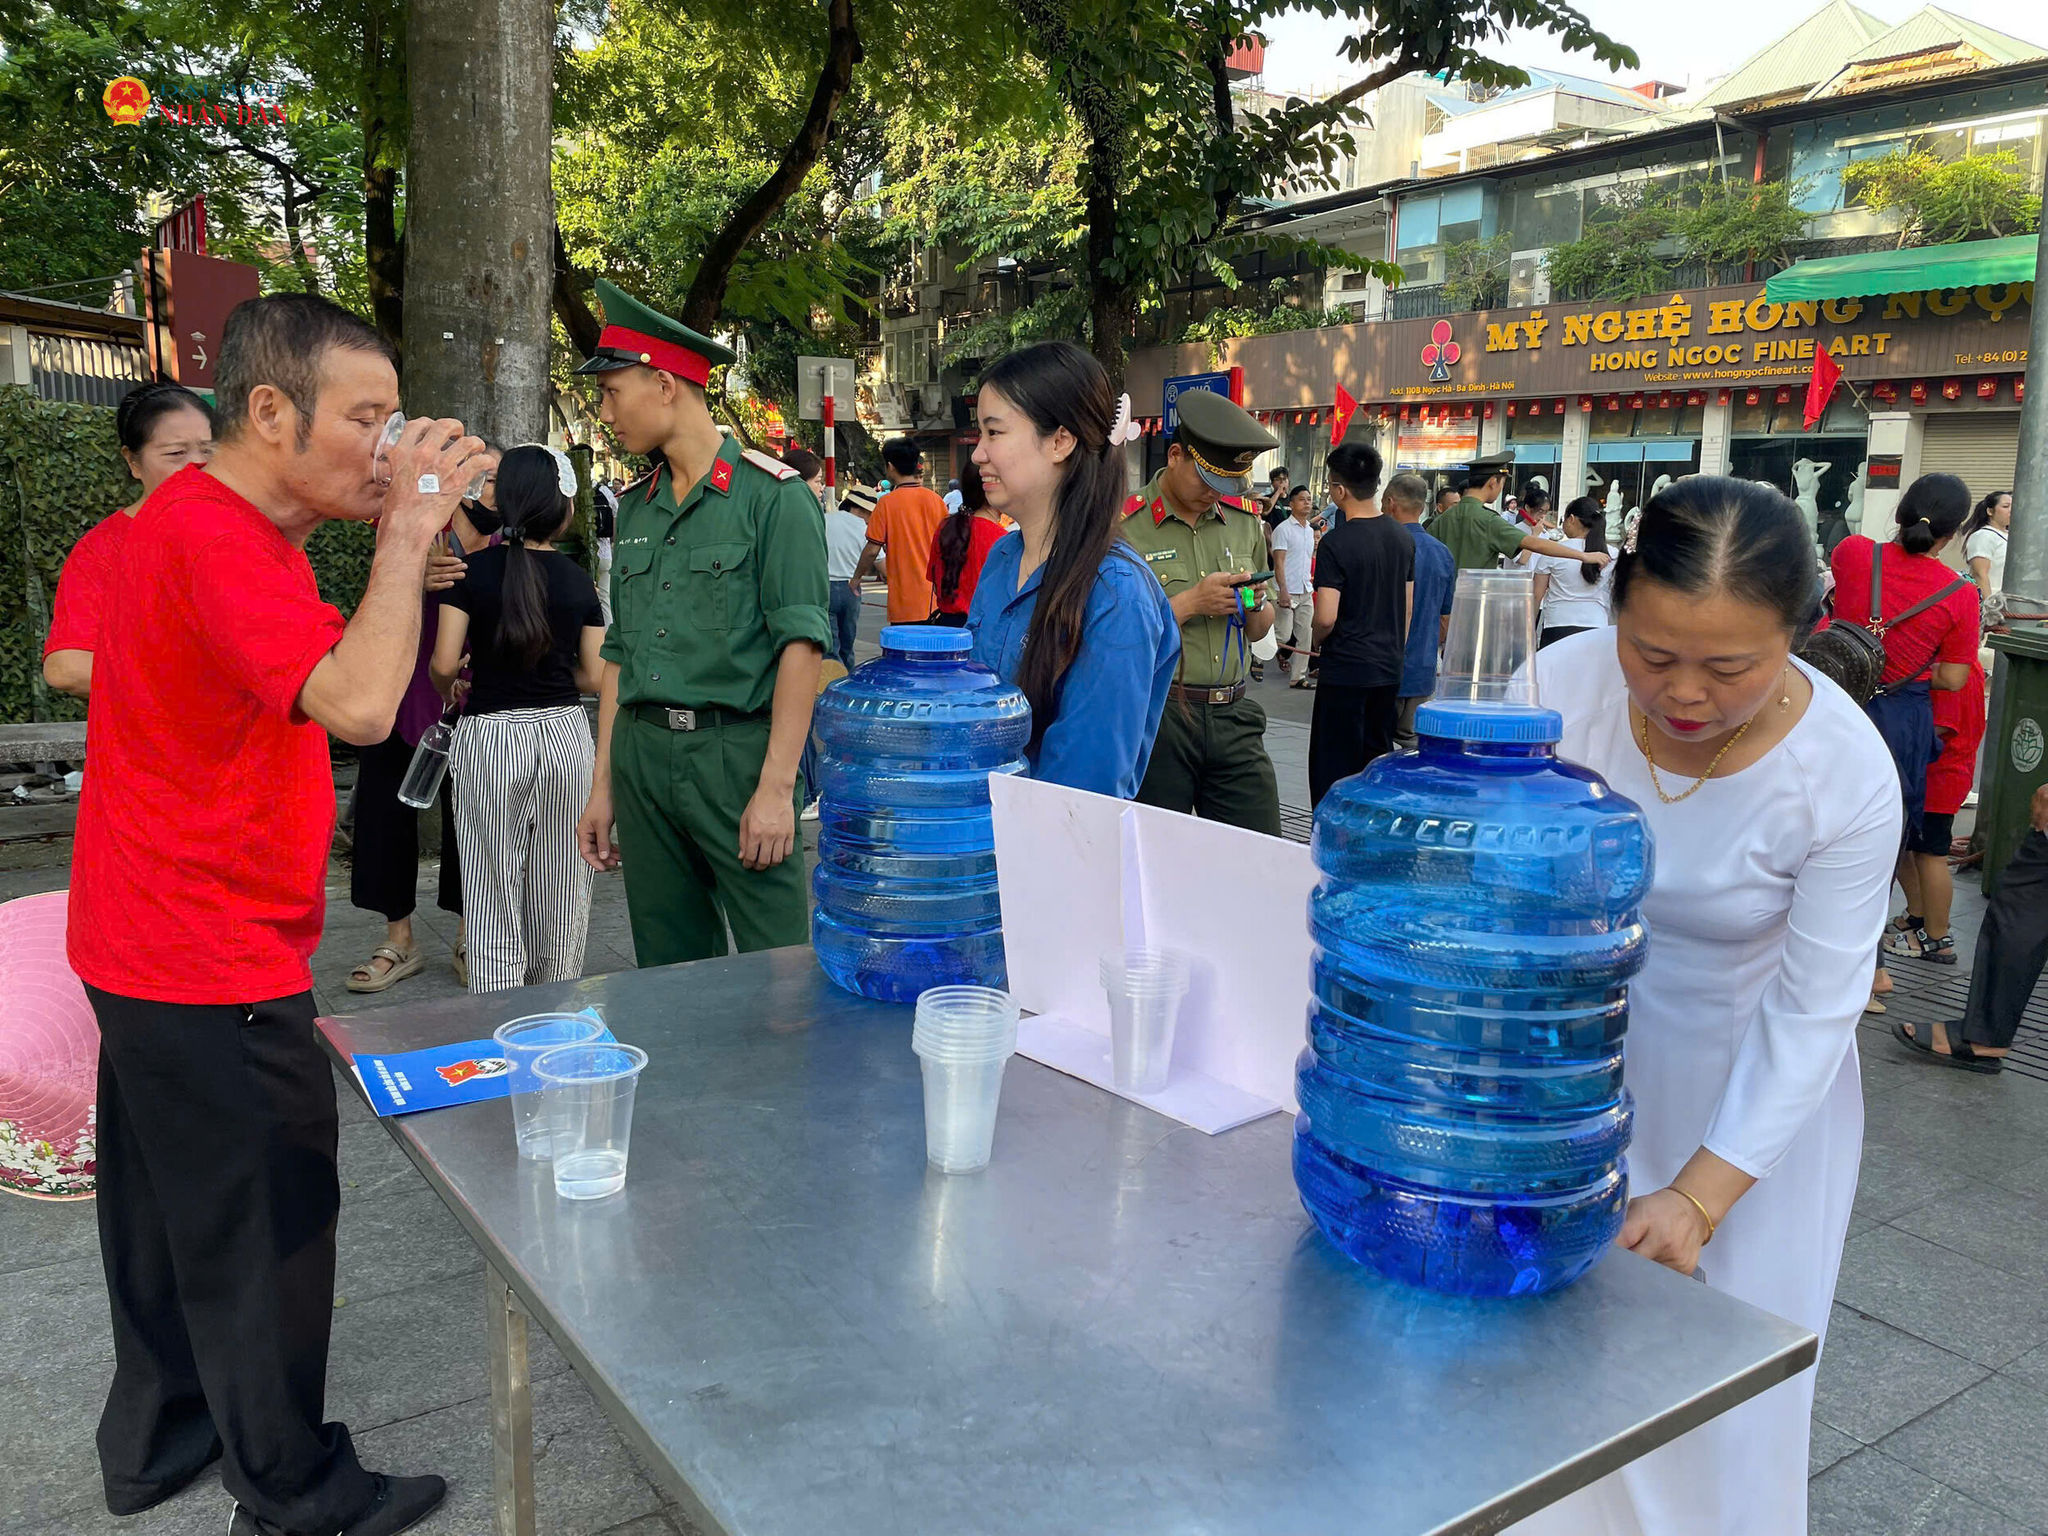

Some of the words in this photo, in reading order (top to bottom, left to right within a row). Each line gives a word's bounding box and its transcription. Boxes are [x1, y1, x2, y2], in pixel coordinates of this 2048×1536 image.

[1485, 310, 1549, 352] MỸ
[1562, 293, 1692, 347] NGHỆ
[1882, 281, 2034, 323] NGỌ
[1590, 350, 1659, 372] HONG
[1668, 343, 1743, 368] NGOC
[1753, 337, 1815, 363] FINE
[1828, 332, 1892, 357] ART
[1976, 351, 2000, 364] +84
[2001, 350, 2018, 363] (0)
[1422, 384, 1441, 396] Ngọc
